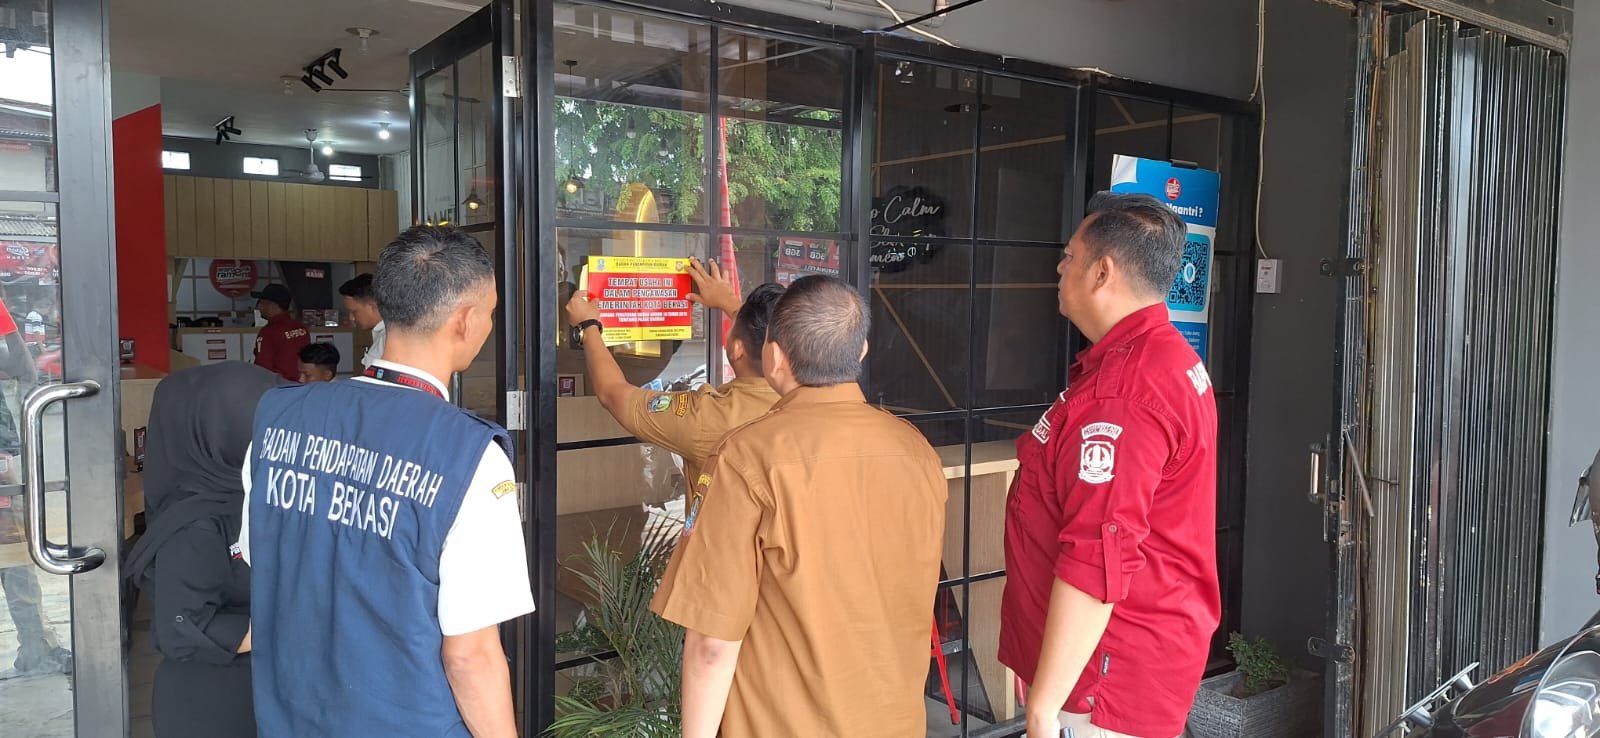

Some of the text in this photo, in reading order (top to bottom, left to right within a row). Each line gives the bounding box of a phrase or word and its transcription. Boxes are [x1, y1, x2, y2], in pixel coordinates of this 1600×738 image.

[883, 195, 941, 224] Calm
[607, 277, 673, 287] TEMPAT USAHA INI
[604, 289, 678, 298] DALAM PENGAWASAN
[598, 300, 689, 309] EMERINTAH KOTA BEKASI
[259, 427, 444, 508] BADAN PENDAPATAN DAERAH
[266, 466, 400, 540] KOTA BEKASI
